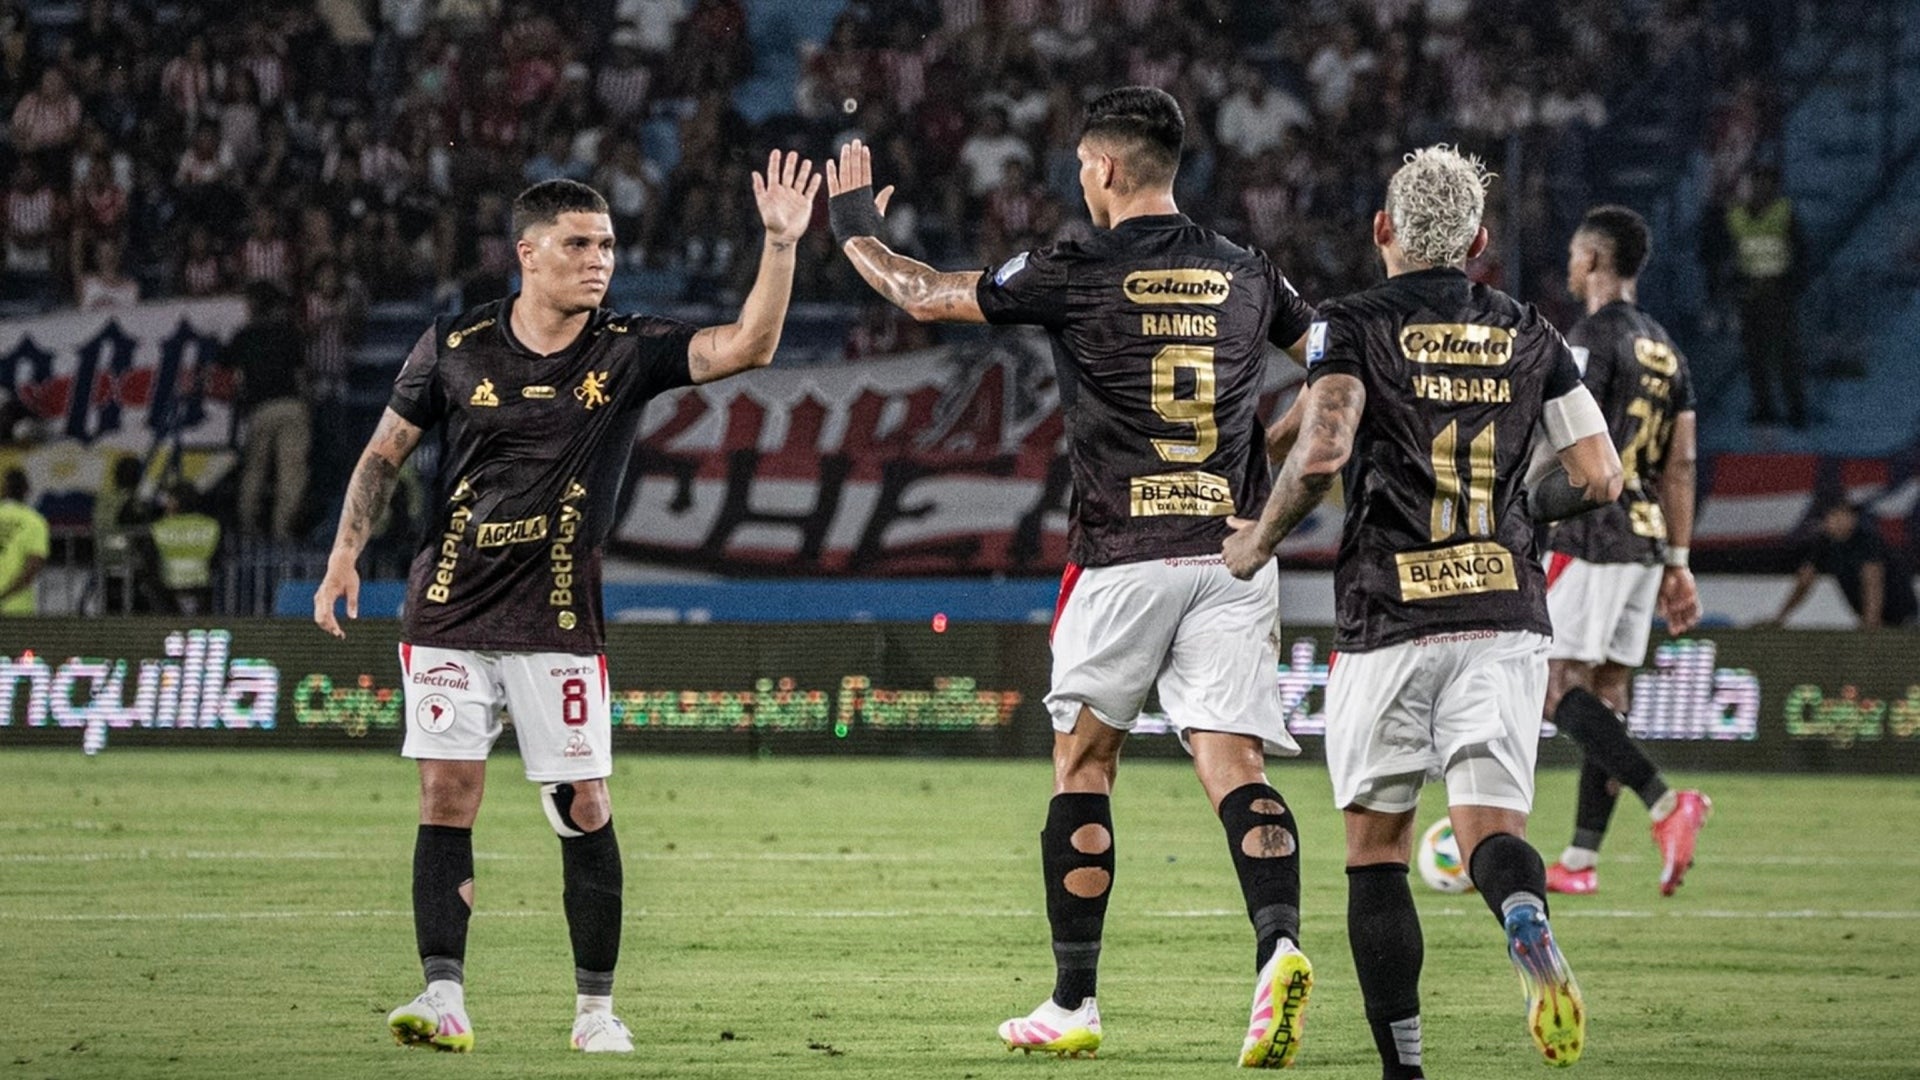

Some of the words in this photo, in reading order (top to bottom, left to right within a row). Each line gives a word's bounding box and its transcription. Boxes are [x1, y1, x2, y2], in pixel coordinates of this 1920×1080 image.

[1126, 277, 1227, 298] Colanta
[1142, 314, 1217, 337] RAMOS
[1403, 331, 1508, 356] Colanta
[1412, 375, 1511, 403] VERGARA
[1150, 344, 1218, 463] 9
[1431, 418, 1496, 543] 11
[1141, 484, 1224, 503] BLANCO
[1157, 503, 1177, 511] DEL
[1180, 503, 1208, 511] VALLE
[426, 505, 474, 604] BetPlay
[551, 505, 582, 606] BetPlay
[1410, 557, 1504, 583] BLANCO
[1430, 583, 1450, 593] DEL
[1454, 579, 1488, 590] VALLE
[1413, 629, 1499, 647] agromercados
[413, 671, 470, 691] Electrolit
[562, 678, 588, 727] 8
